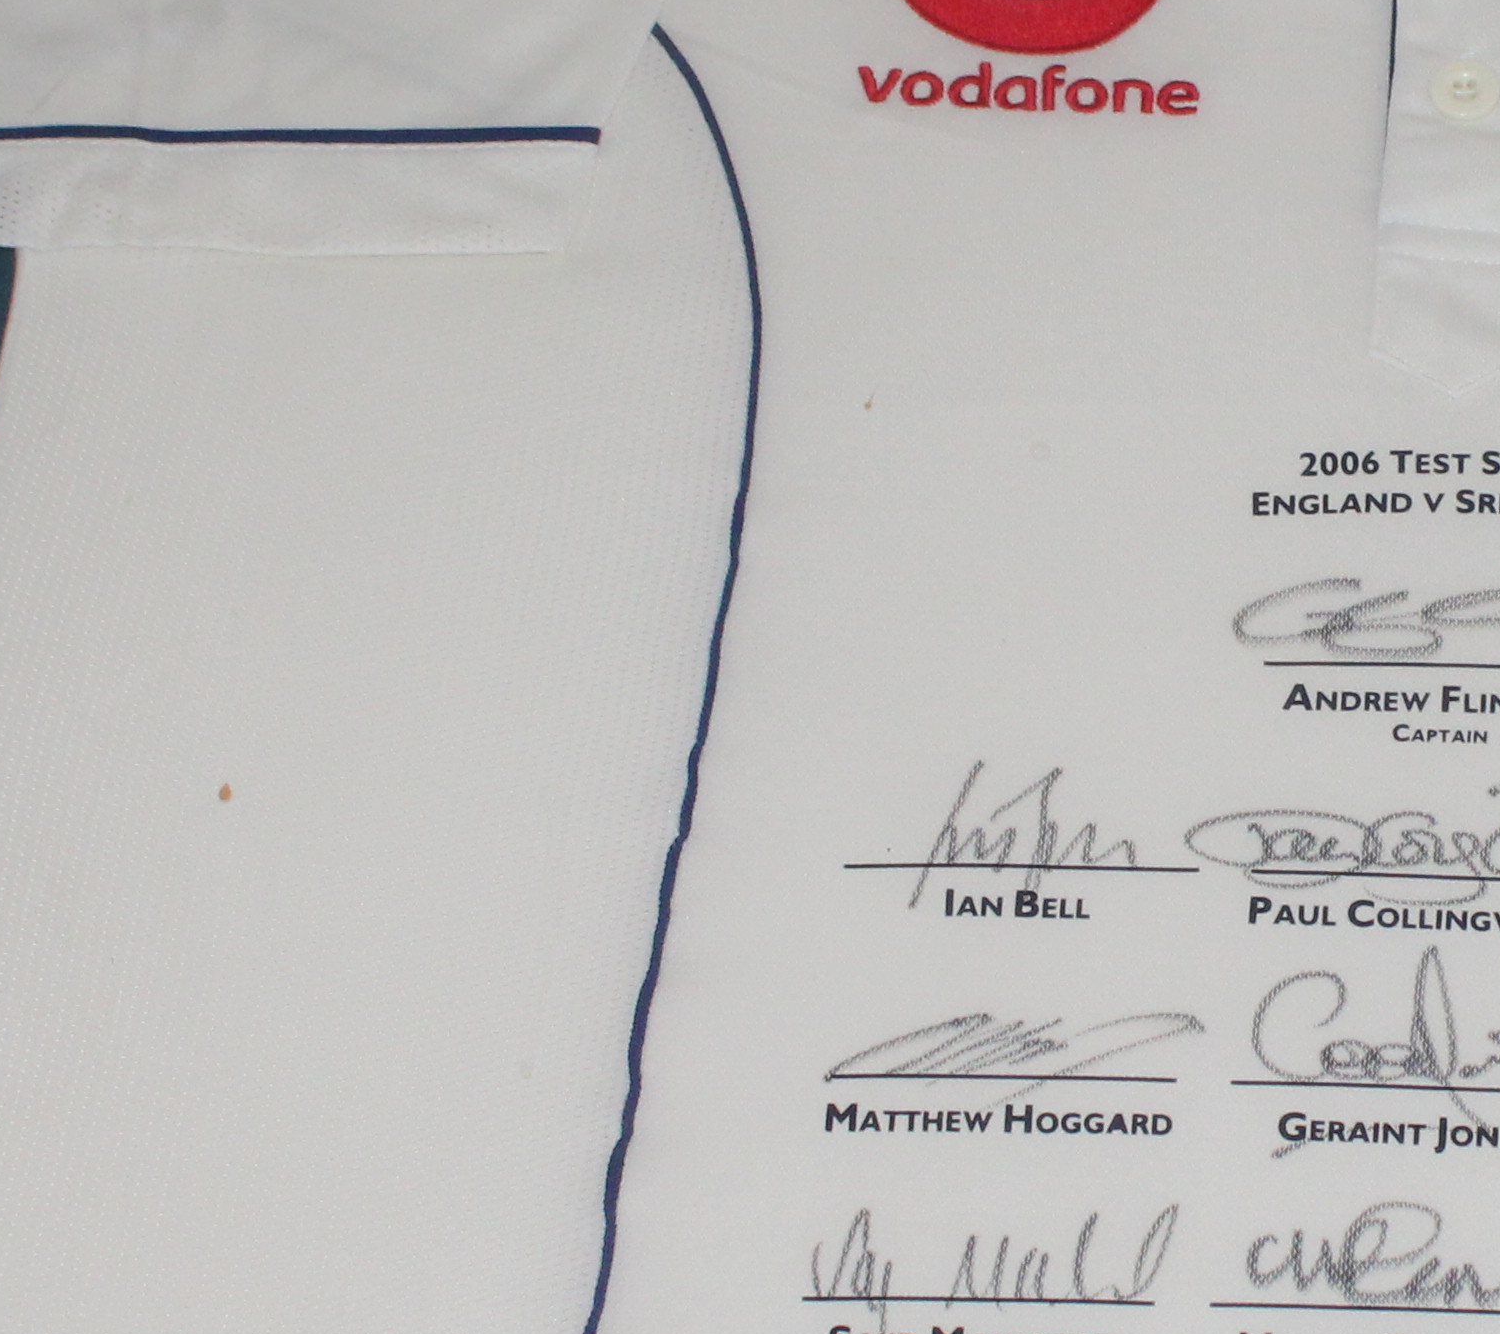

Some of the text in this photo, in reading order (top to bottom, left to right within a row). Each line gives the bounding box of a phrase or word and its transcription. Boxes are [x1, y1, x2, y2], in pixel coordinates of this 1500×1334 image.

[858, 62, 1200, 115] vodafone
[1300, 451, 1380, 477] 2006
[1389, 450, 1471, 475] TEST
[1252, 492, 1413, 516] ENGLAND
[1283, 683, 1430, 712] ANDREW
[1392, 724, 1487, 743] CAPTAIN
[945, 888, 1089, 919] IAN BELL
[1248, 896, 1336, 926] PAUL
[825, 1103, 1173, 1136] MATTHEW HOGGARD
[1278, 1112, 1427, 1145] GERAINT
